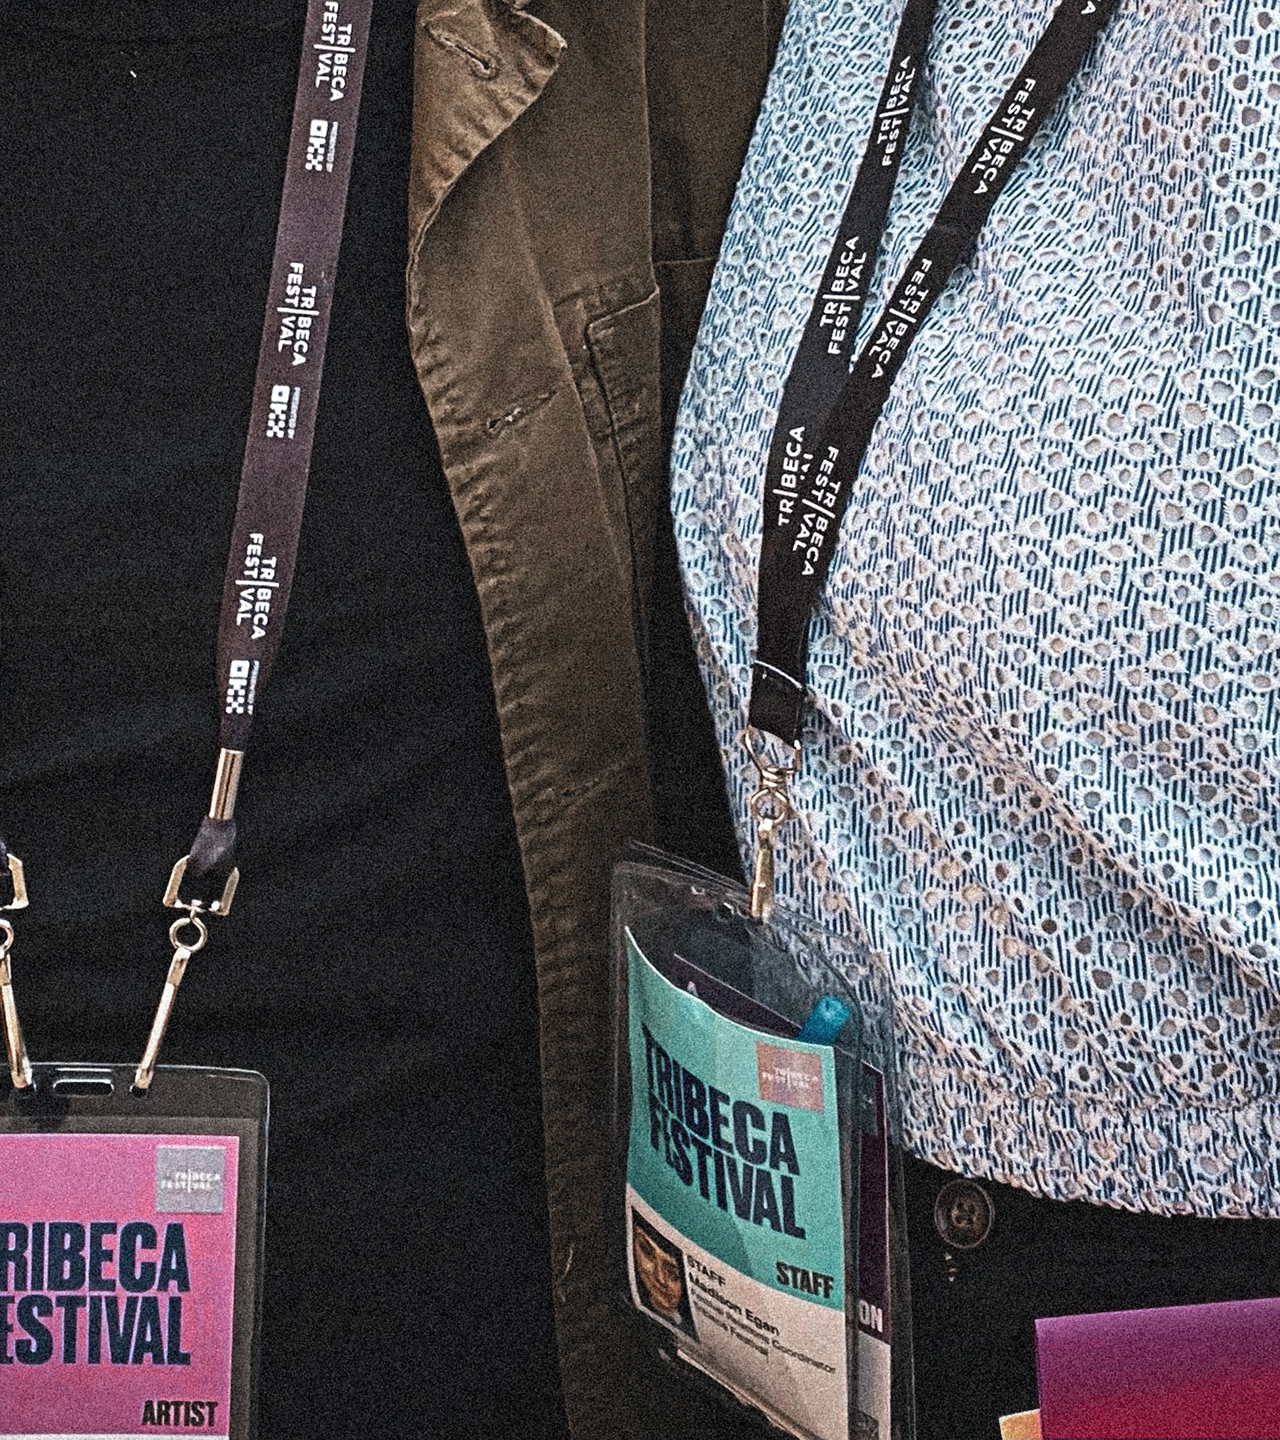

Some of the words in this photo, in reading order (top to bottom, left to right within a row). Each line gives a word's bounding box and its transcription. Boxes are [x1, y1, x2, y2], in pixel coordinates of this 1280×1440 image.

[314, 0, 340, 88] FESTIVAL
[328, 22, 356, 102] TRIBECA
[877, 55, 911, 146] TRIBECA
[881, 67, 916, 166] FESTIVAL
[971, 77, 1036, 184] FESTIVAL
[974, 104, 1036, 195] TRIBECA
[277, 262, 305, 353] FESTIVAL
[291, 284, 319, 367] TRIBECA
[820, 236, 860, 328] TRIBECA
[827, 251, 867, 355] FESTIVAL
[869, 258, 933, 358] FESTIVAL
[871, 287, 930, 379] TRIBECA
[773, 425, 806, 527] TRIBECA
[793, 446, 840, 552] FESTIVAL
[802, 480, 841, 576] TRIBECA
[235, 532, 264, 627] FESTIVAL
[250, 555, 279, 641] TRIBECA
[640, 1021, 800, 1177] TRIBECA
[647, 1090, 807, 1241] FESTIVAL
[745, 1307, 781, 1337] Egan
[775, 1261, 835, 1300] STAFF
[140, 1399, 219, 1428] ARTIST
